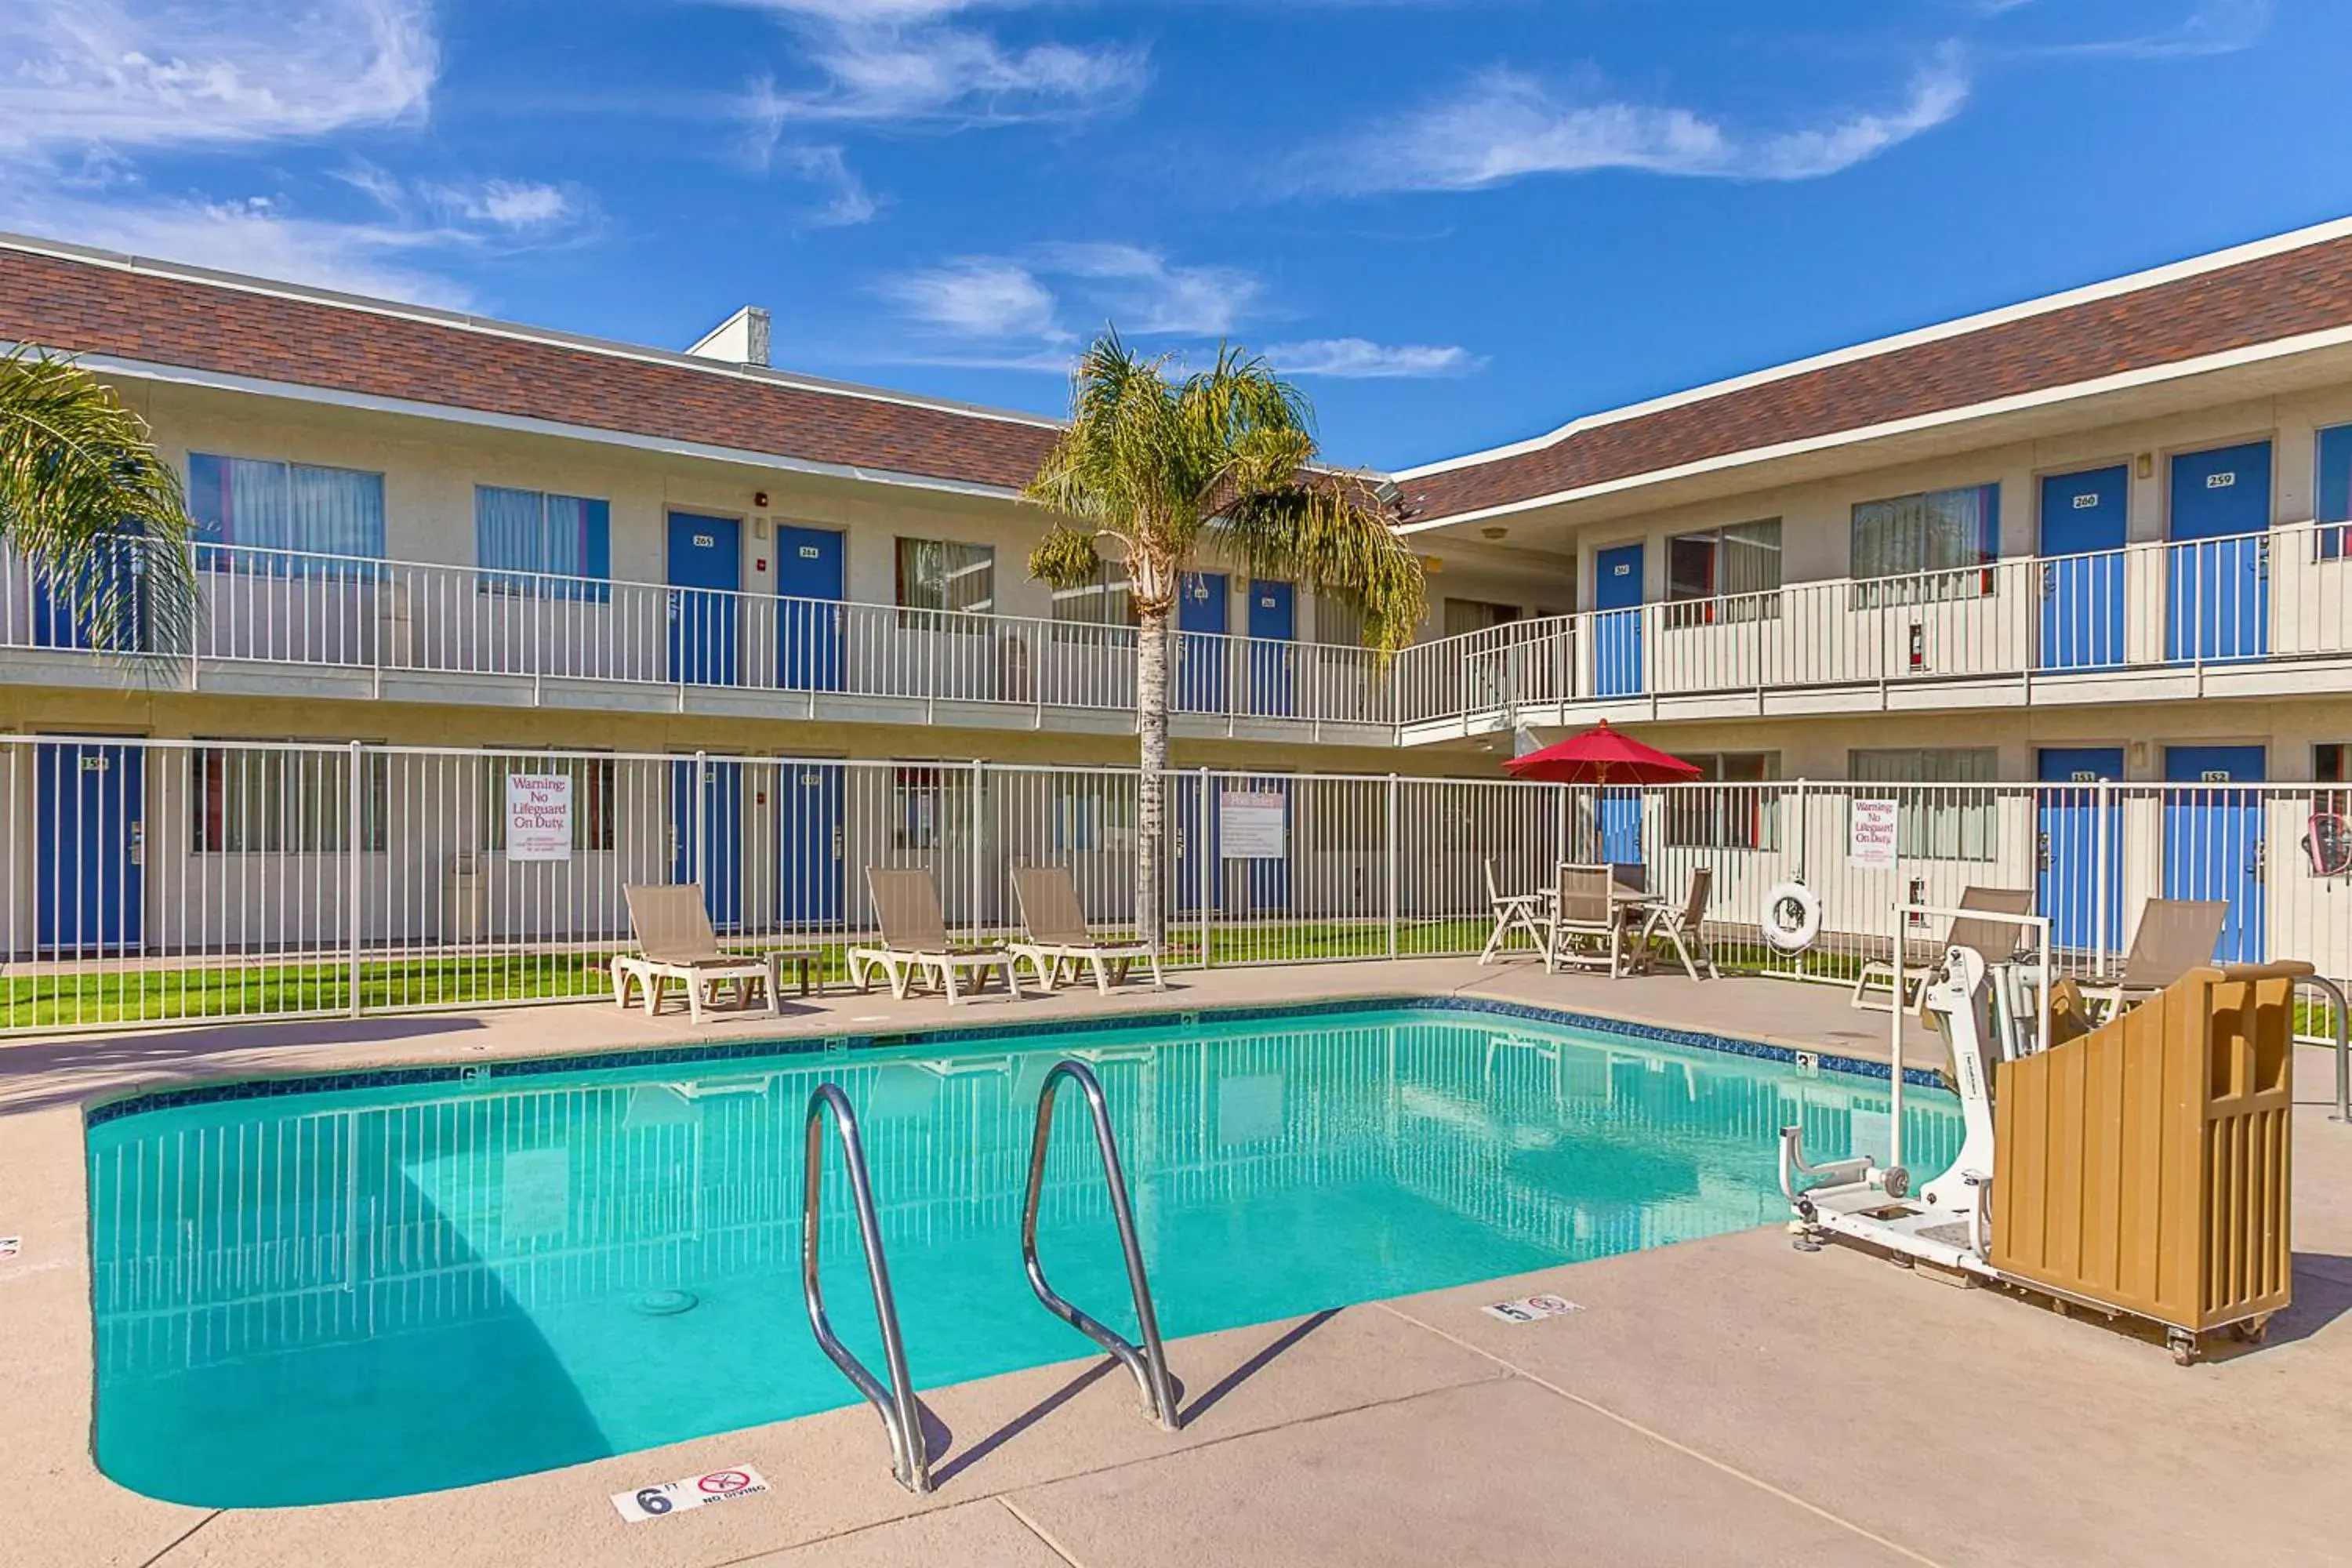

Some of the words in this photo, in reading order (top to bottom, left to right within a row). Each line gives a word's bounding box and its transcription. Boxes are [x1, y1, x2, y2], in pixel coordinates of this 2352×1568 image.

[2209, 475, 2232, 487] 259
[2076, 495, 2095, 507] 260
[2205, 773, 2226, 782] 152
[514, 777, 565, 793] Warning:
[531, 791, 549, 803] No
[514, 803, 566, 817] Lifeguard
[514, 817, 532, 828] On
[1869, 812, 1881, 822] No
[1856, 822, 1893, 833] Lifeguard
[1856, 833, 1870, 843] On
[1493, 1304, 1533, 1320] 5
[636, 1488, 673, 1515] 6
[665, 1483, 679, 1492] FT
[702, 1495, 720, 1504] NO
[724, 1485, 766, 1498] DIVING
